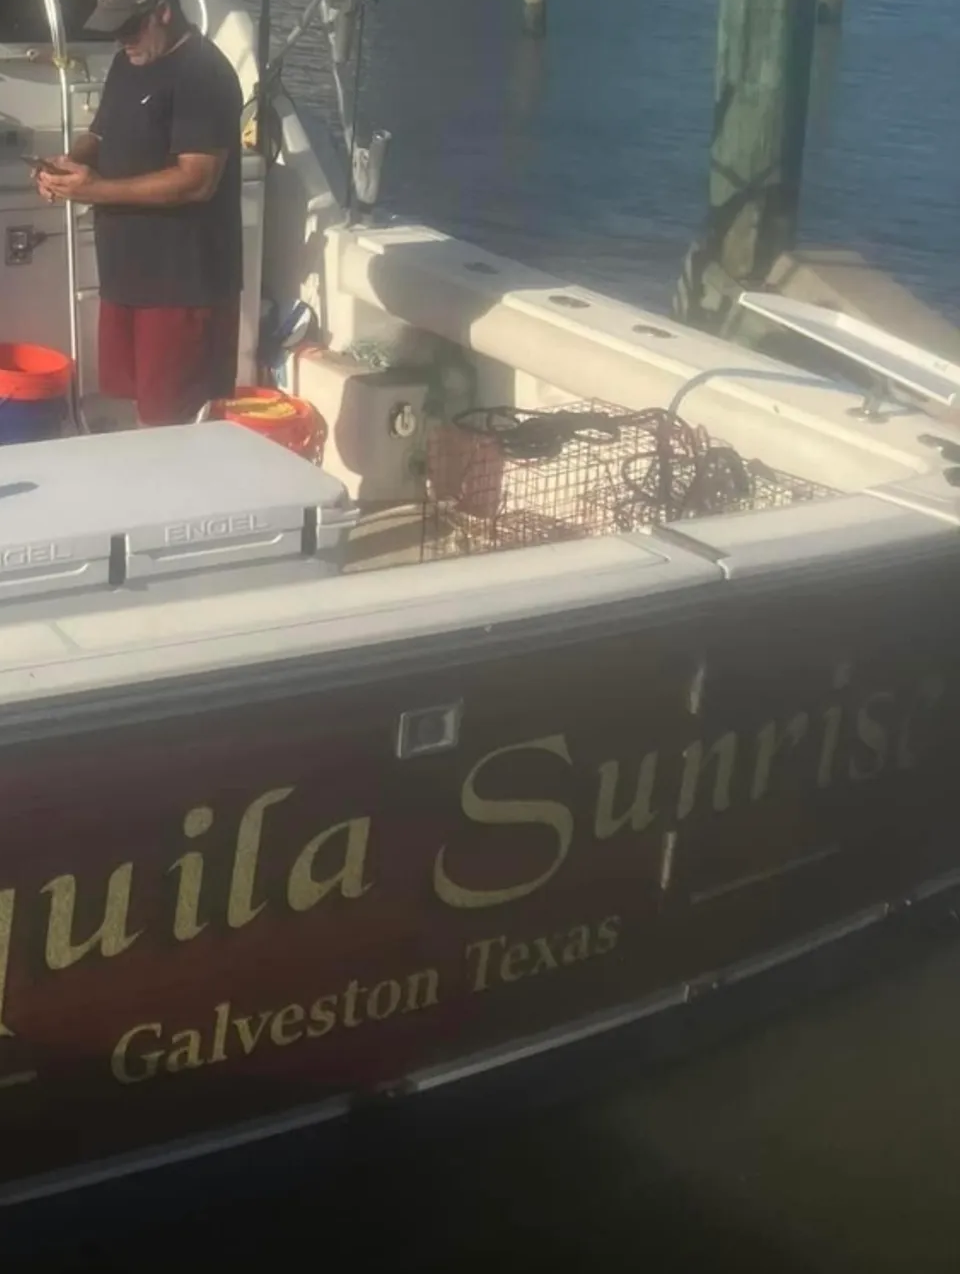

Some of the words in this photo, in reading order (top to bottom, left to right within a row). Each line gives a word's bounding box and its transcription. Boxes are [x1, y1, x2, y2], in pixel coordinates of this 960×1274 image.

[164, 512, 269, 545] ENGEL
[109, 967, 440, 1085] Galveston
[465, 914, 622, 994] Texas
